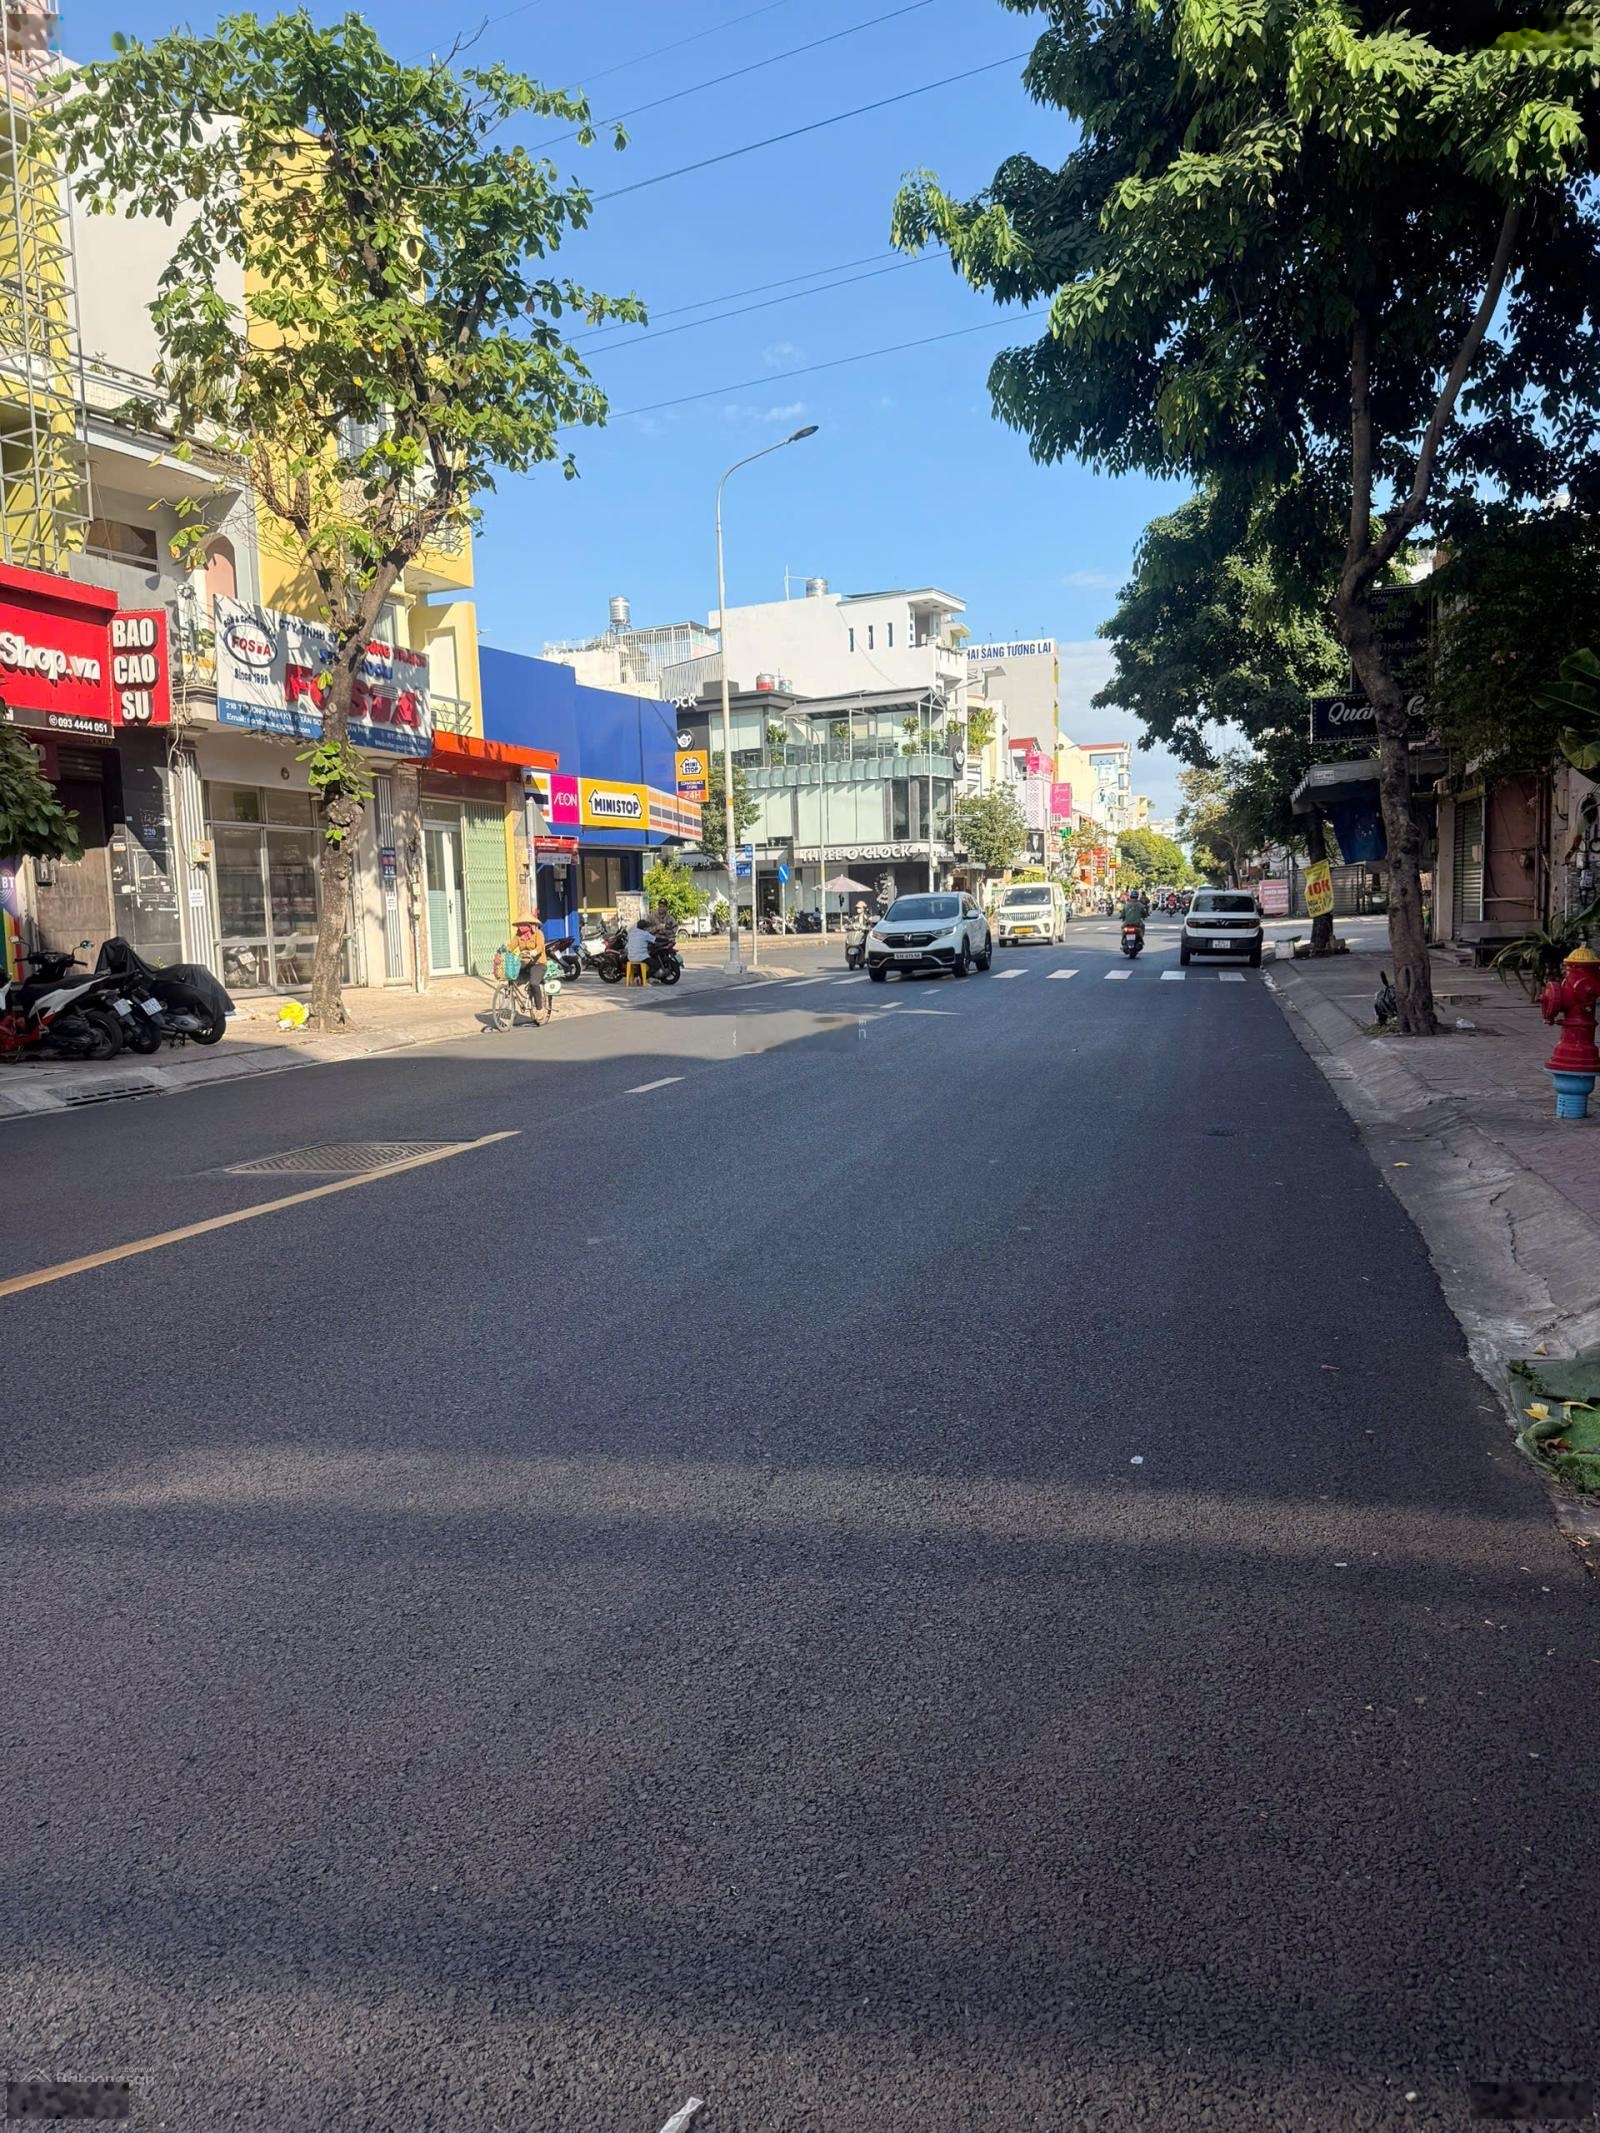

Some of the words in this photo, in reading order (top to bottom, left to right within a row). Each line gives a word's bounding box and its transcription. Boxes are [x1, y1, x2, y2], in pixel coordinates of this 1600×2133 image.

[112, 617, 155, 650] BAO
[1037, 641, 1051, 654] LAI
[113, 654, 156, 685] CAO
[121, 691, 151, 720] SU
[663, 693, 697, 708] OCK
[58, 717, 73, 730] 093
[74, 721, 92, 733] 4444
[93, 724, 108, 734] 051
[684, 762, 698, 773] MINI
[594, 797, 639, 815] MINISTOP
[800, 849, 843, 862] THREE
